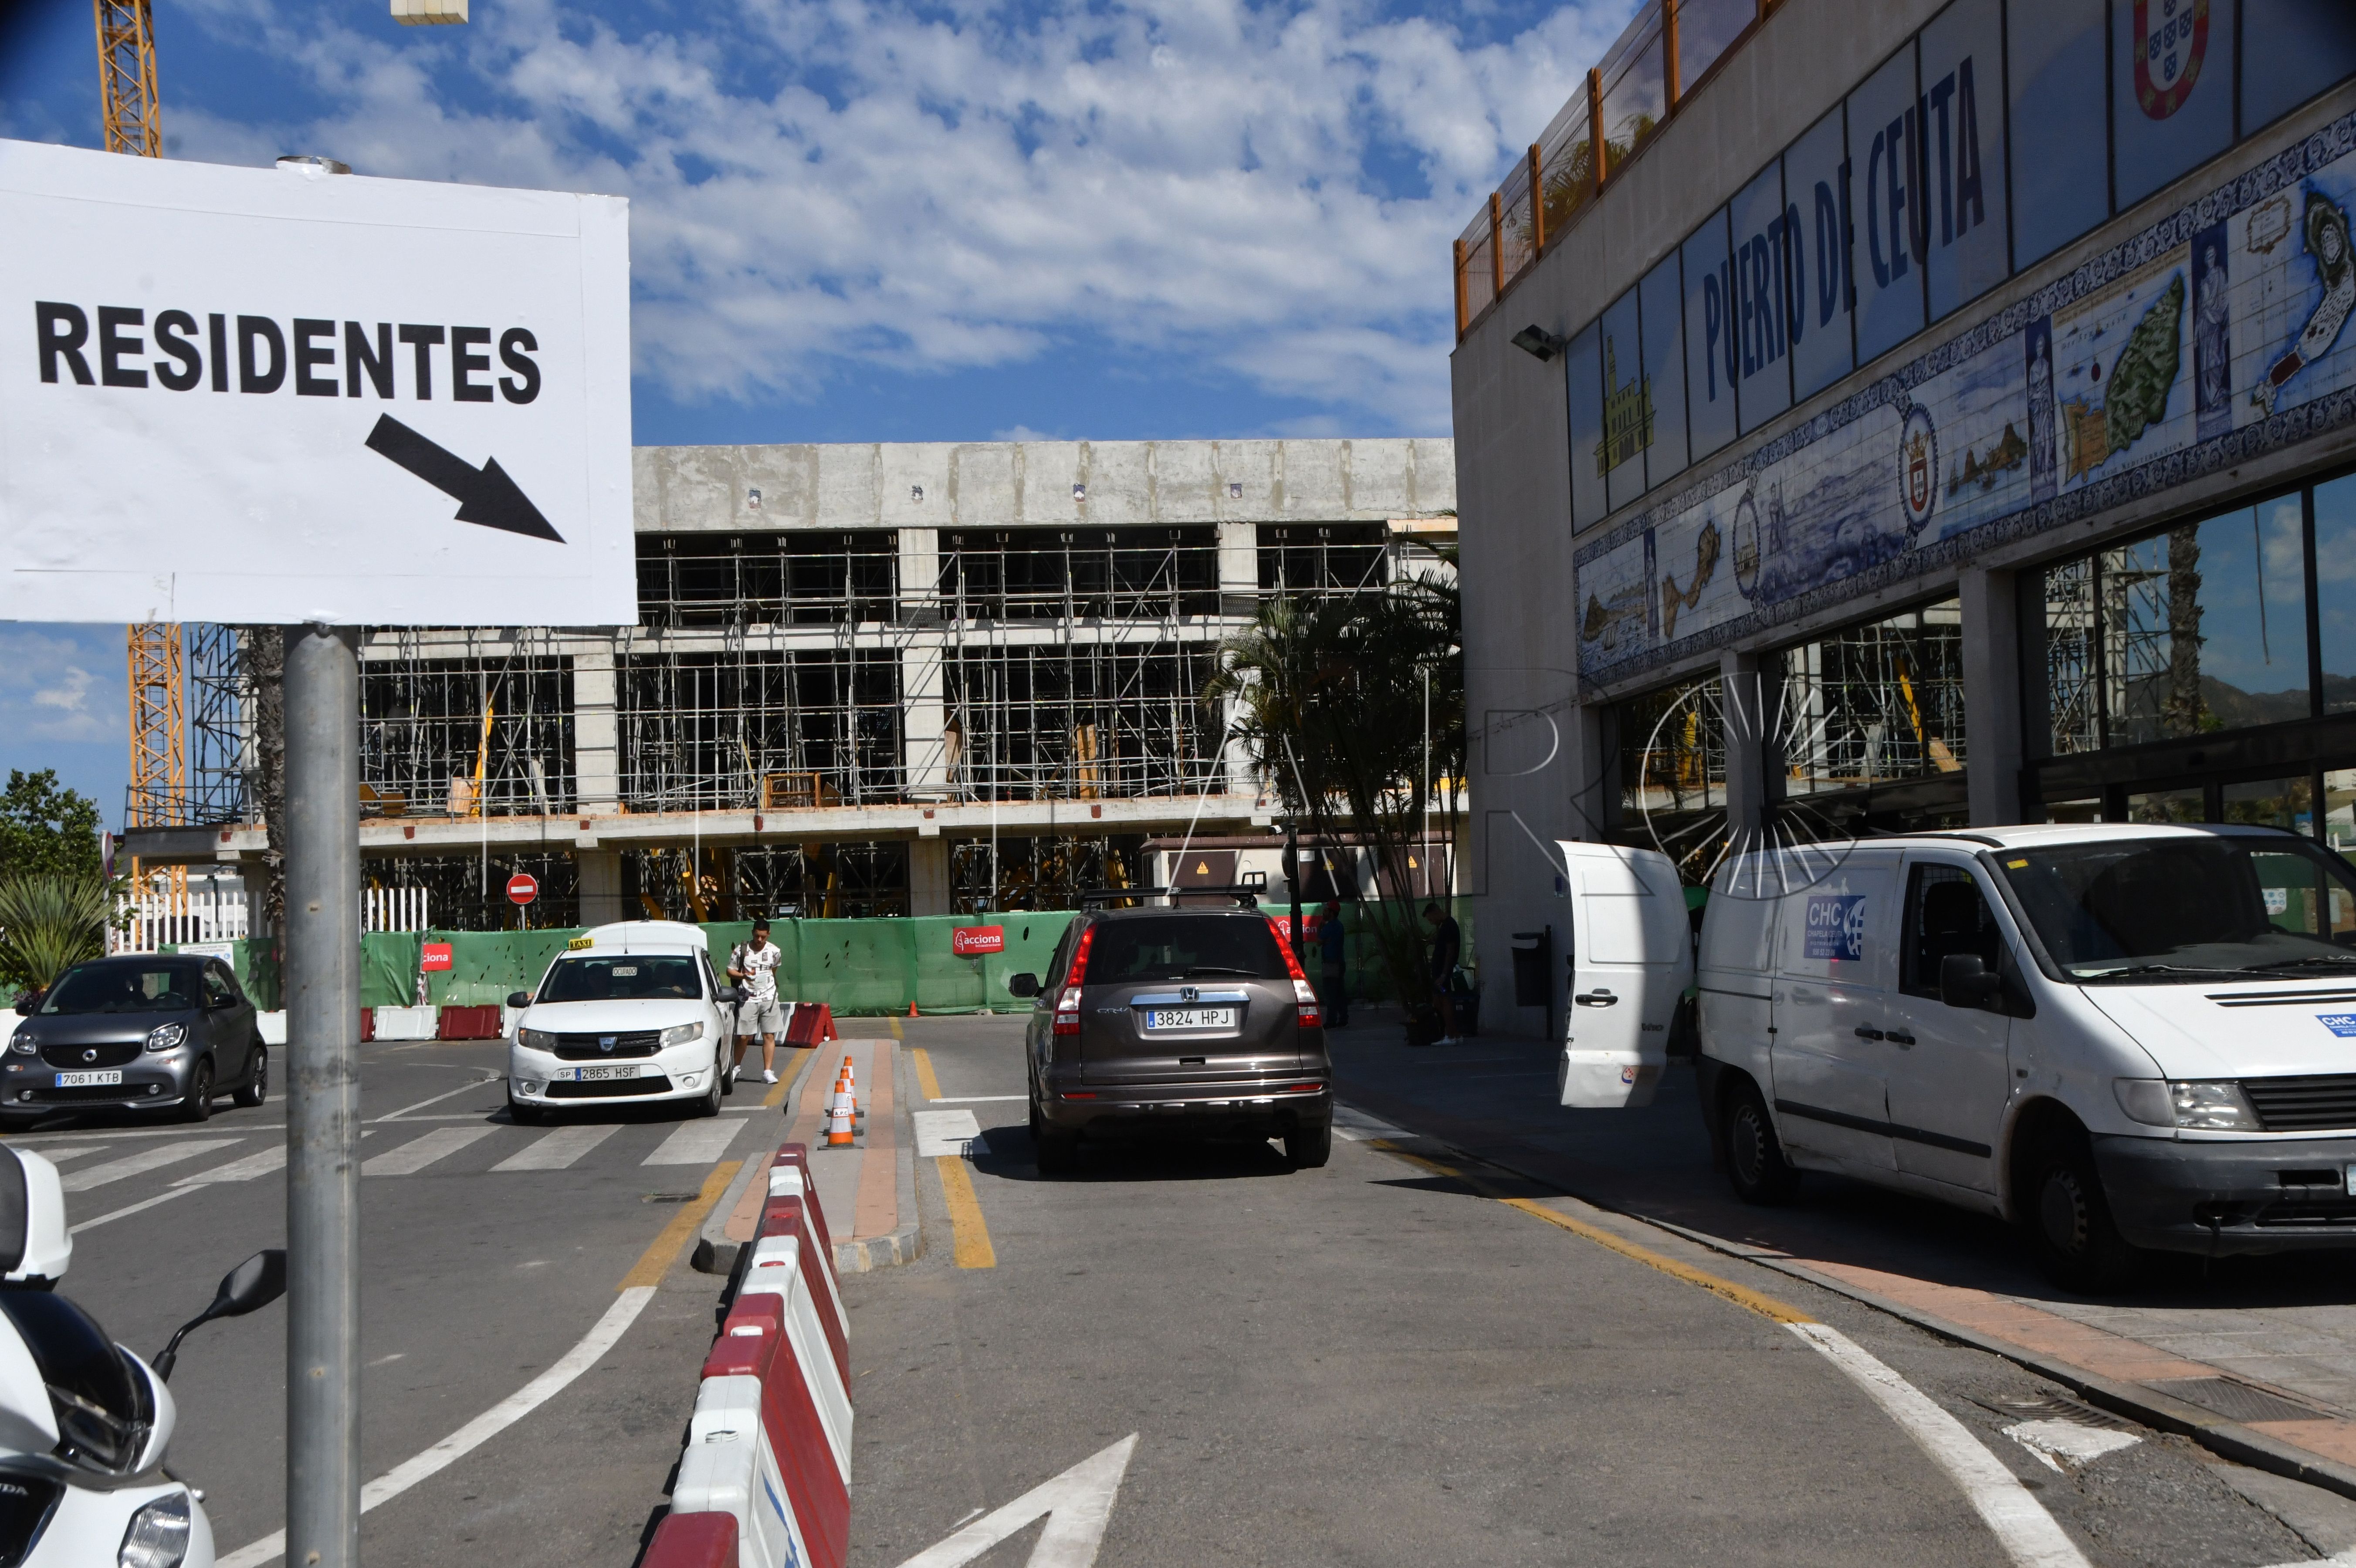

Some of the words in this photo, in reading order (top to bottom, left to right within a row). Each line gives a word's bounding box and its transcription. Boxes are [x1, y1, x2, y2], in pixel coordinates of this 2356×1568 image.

[1703, 203, 1805, 402] PUERTO
[1814, 156, 1857, 329] DE
[1867, 54, 1985, 290] CEUTA
[35, 300, 541, 405] RESIDENTES
[1809, 902, 1842, 926] CHC
[964, 934, 1001, 944] acciona
[1157, 1011, 1193, 1026] 3824
[1201, 1010, 1229, 1025] HPJ
[2322, 1016, 2356, 1025] CHC
[64, 1074, 92, 1085] 7061
[97, 1073, 119, 1083] KTB
[582, 1068, 609, 1079] 2865
[616, 1067, 635, 1078] HSF
